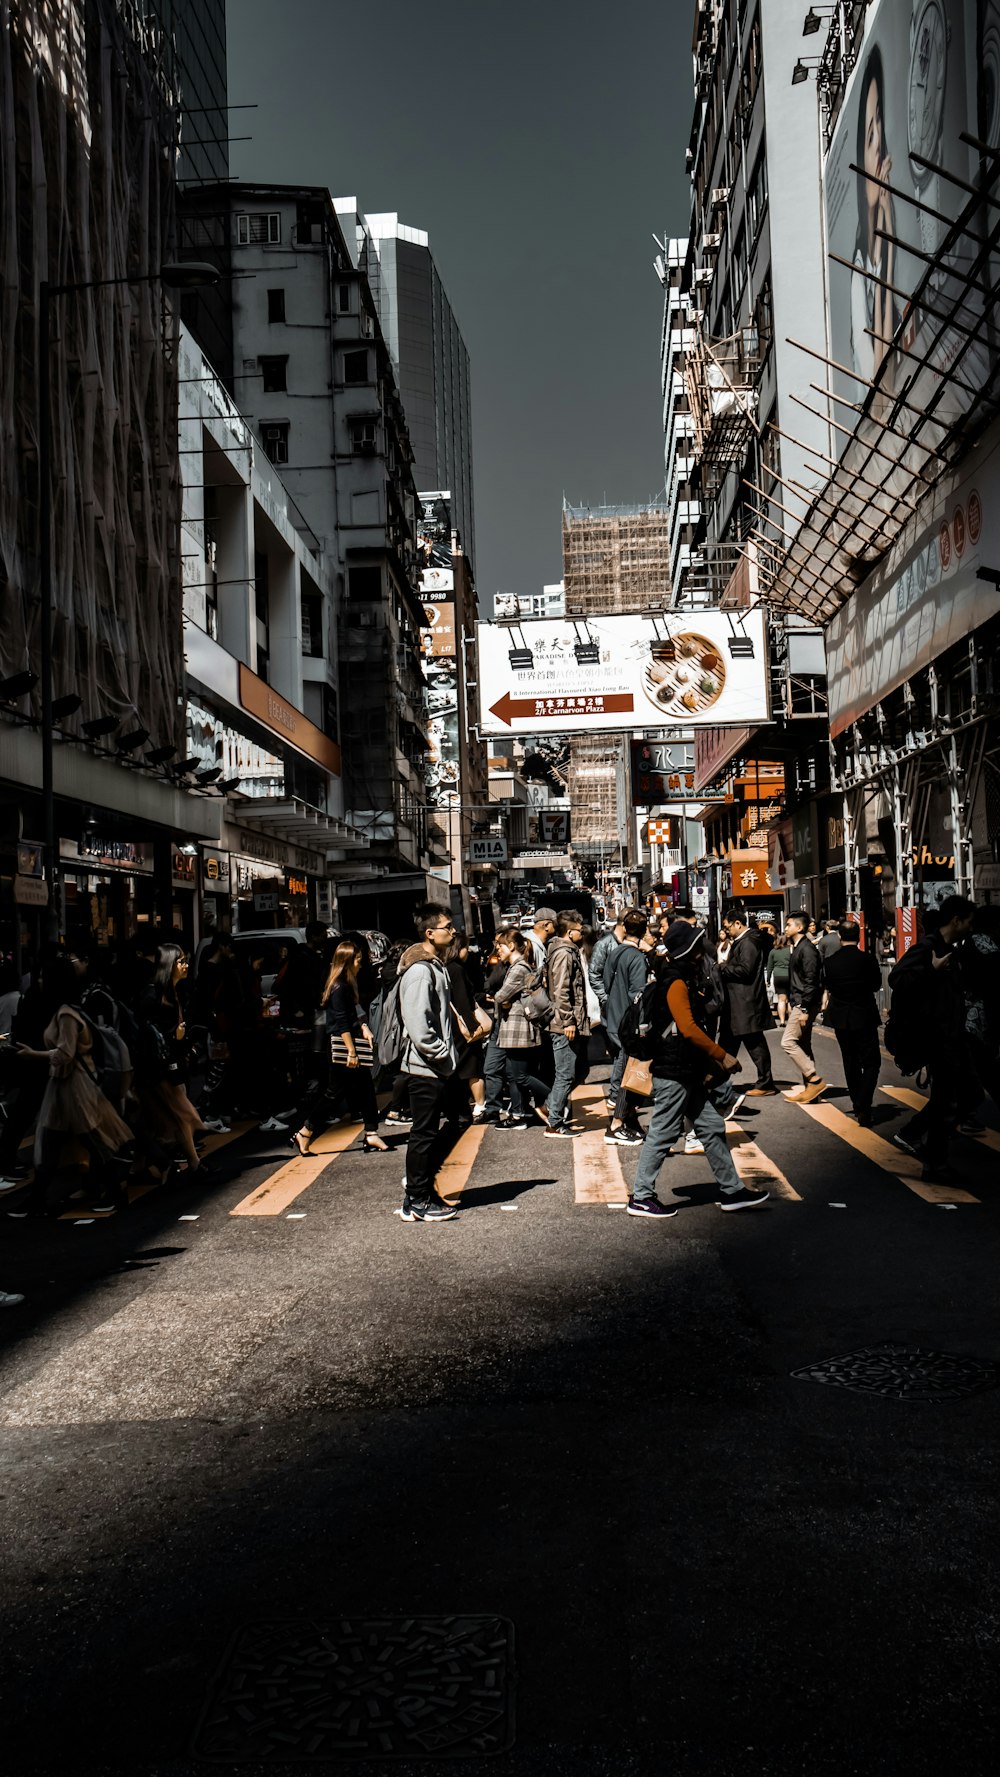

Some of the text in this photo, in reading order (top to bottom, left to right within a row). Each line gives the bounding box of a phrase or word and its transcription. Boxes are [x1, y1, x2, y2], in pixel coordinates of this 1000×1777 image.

[519, 688, 557, 696] International
[548, 706, 585, 715] Carnarvon
[585, 705, 605, 713] Plaza
[473, 842, 504, 854] MIA
